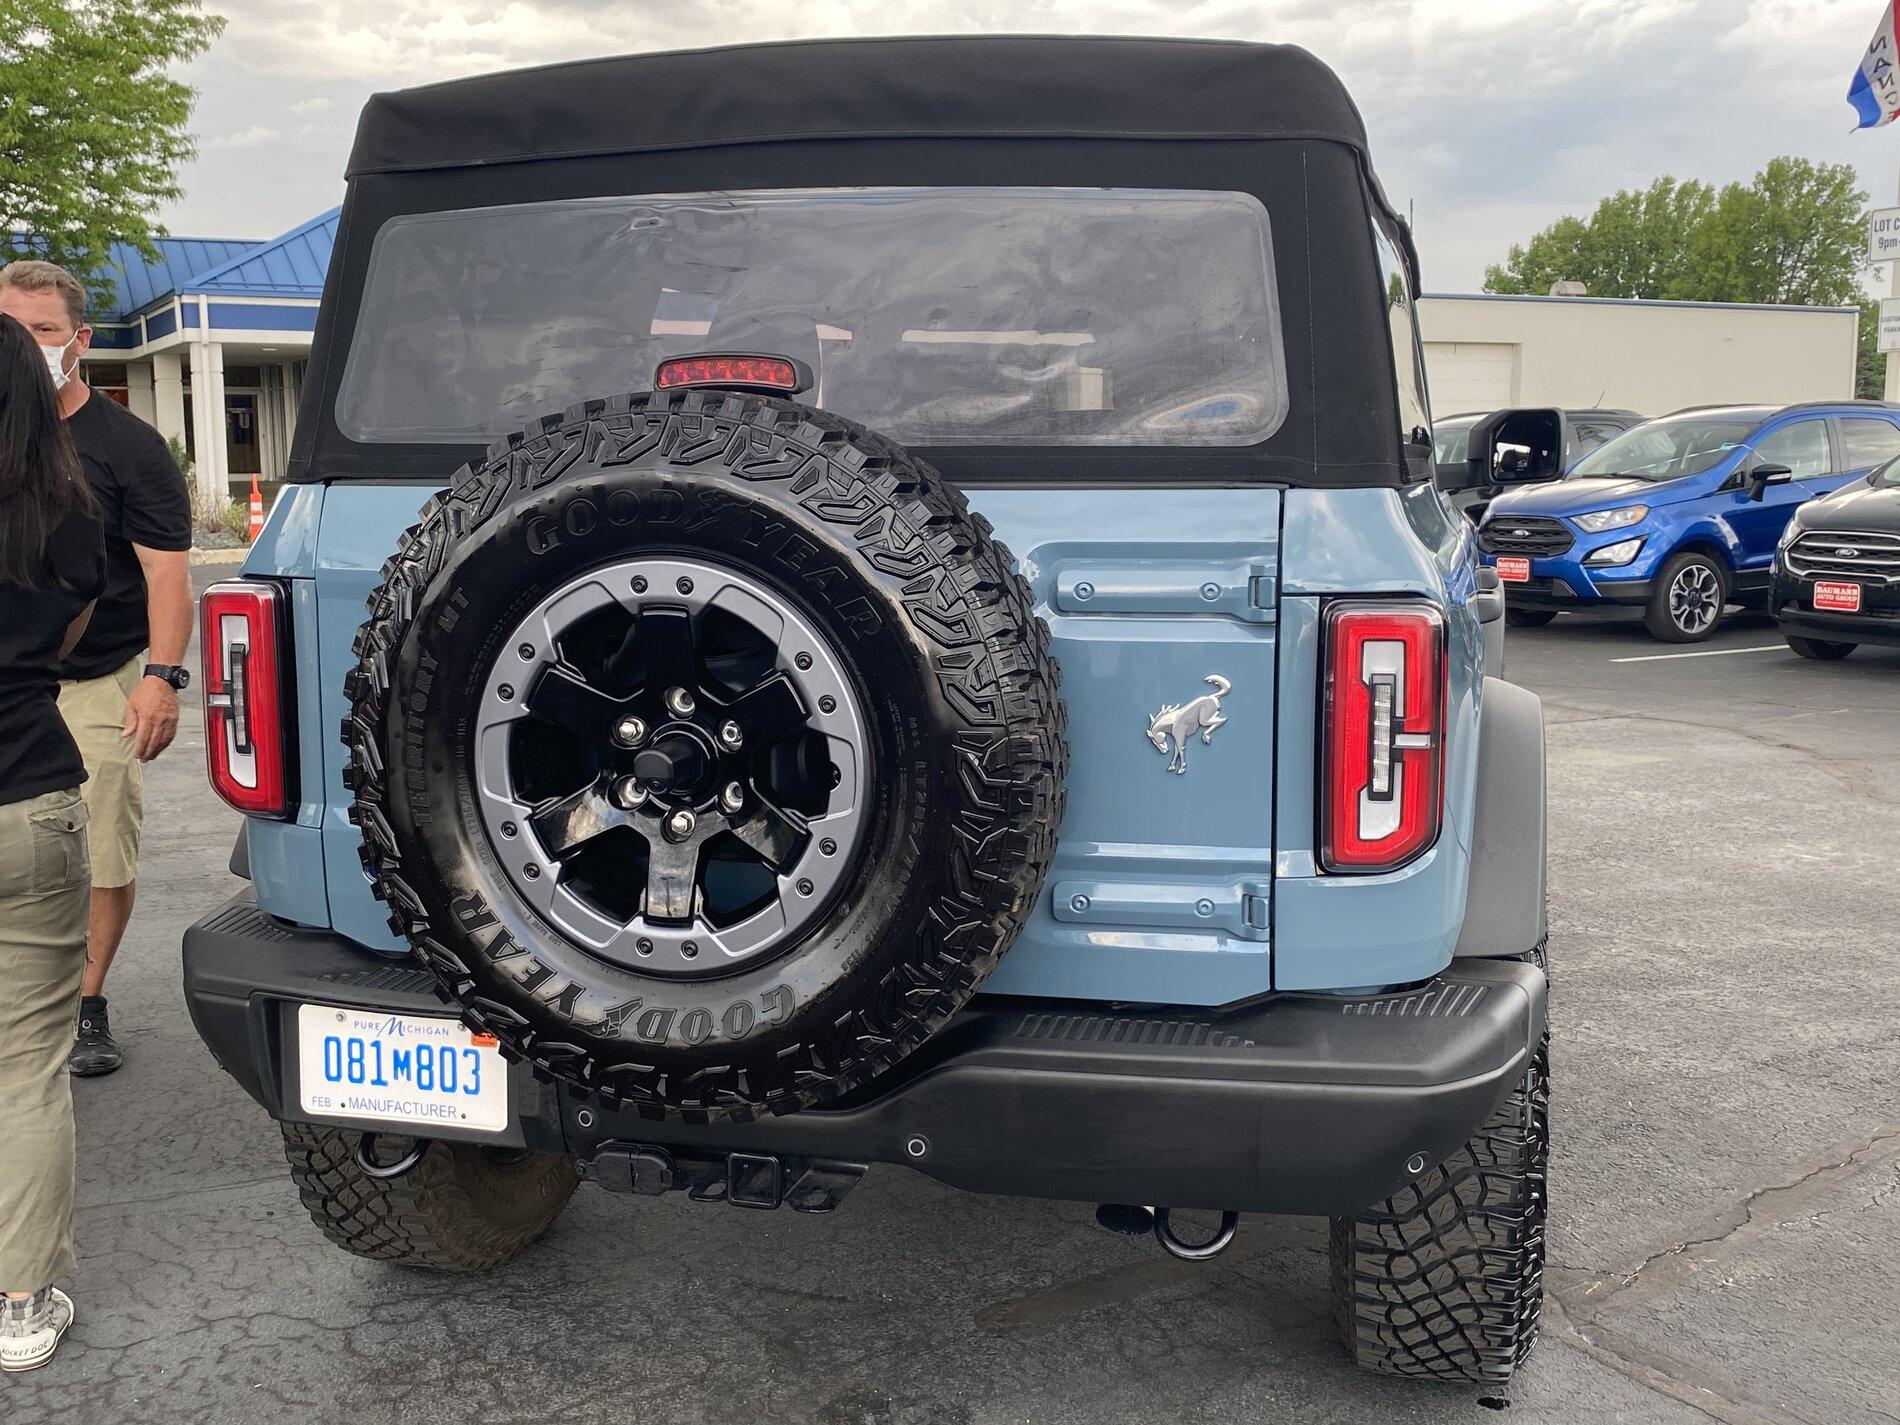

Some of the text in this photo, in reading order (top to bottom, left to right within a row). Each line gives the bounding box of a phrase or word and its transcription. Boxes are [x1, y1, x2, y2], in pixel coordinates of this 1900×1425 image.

[1874, 218, 1891, 232] LOT
[438, 587, 470, 634] MT
[354, 1016, 450, 1037] PURE MICHIGAN
[323, 1035, 481, 1096] 081M803
[312, 1096, 458, 1119] FEB MANUFACTURER
